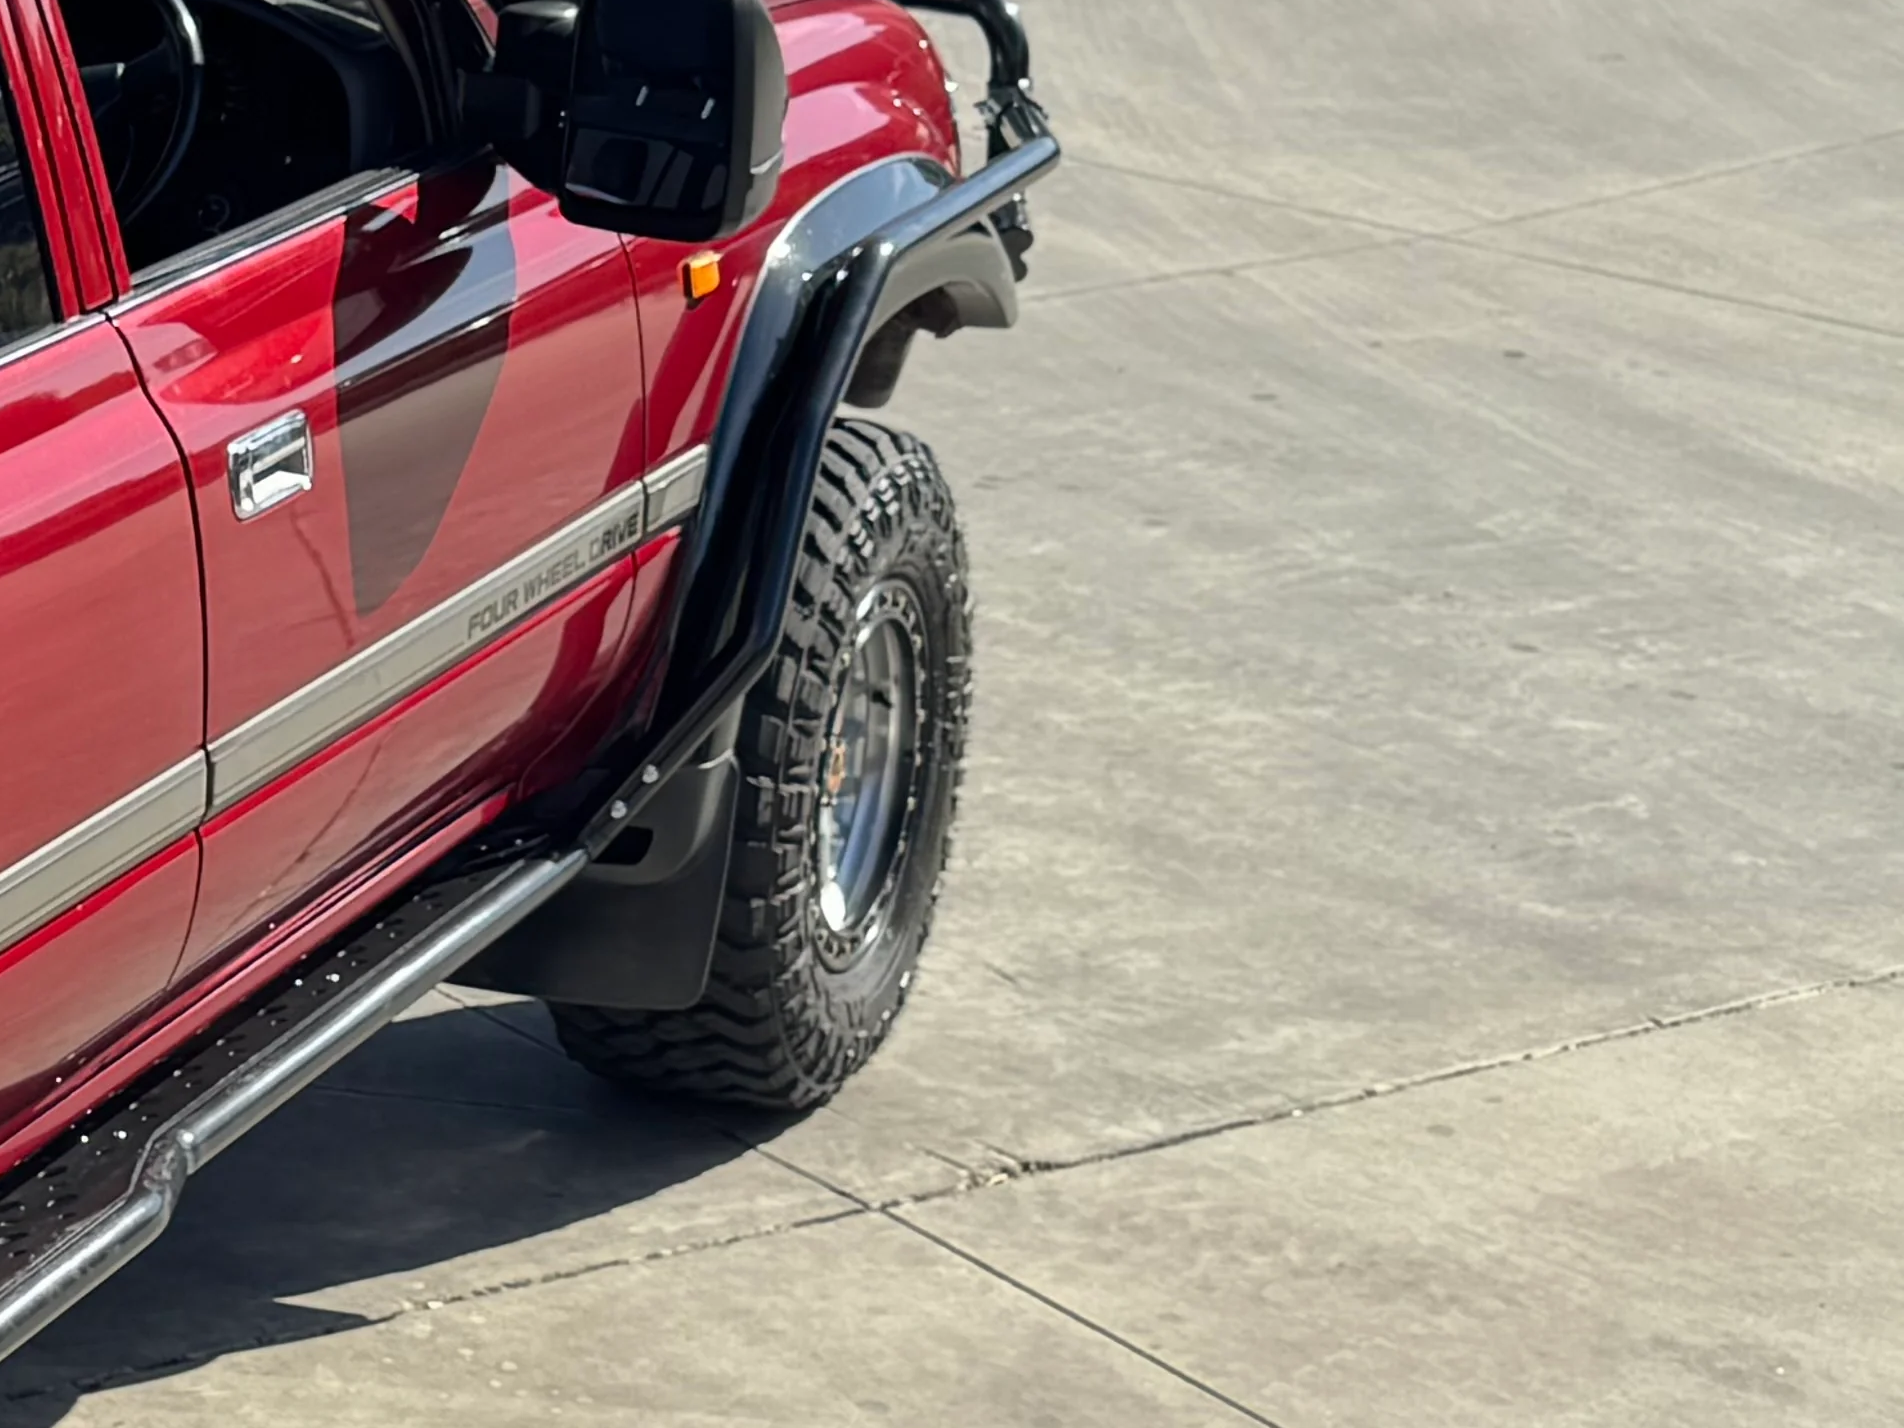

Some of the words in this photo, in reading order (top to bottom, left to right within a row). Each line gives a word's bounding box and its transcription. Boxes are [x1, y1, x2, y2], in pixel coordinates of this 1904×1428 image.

[466, 587, 520, 642] FOUR
[521, 548, 587, 604] WHEEL
[589, 511, 640, 565] DRIVE
